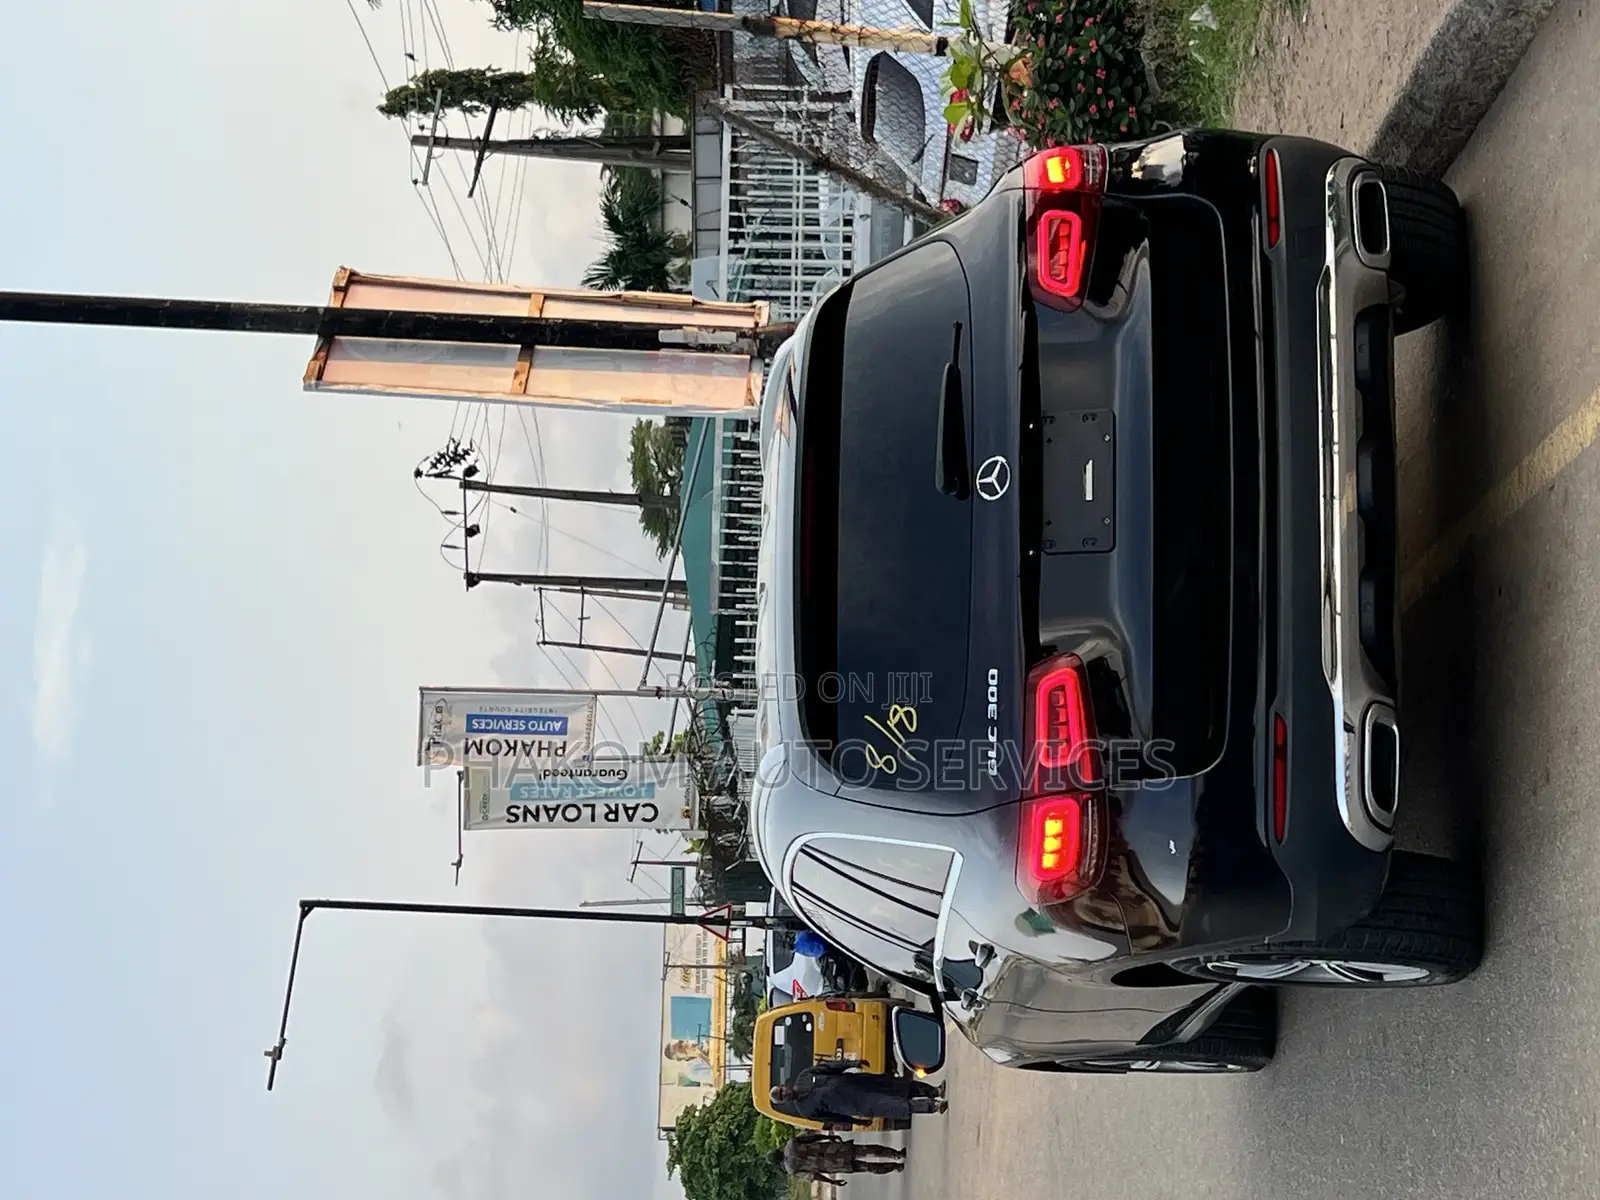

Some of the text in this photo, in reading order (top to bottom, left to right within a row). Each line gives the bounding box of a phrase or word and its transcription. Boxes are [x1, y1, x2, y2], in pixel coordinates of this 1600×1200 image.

[471, 718, 563, 732] AUTO SERVICES
[987, 668, 998, 776] GLC 300
[464, 737, 567, 757] PHAKOM
[539, 768, 628, 781] Guaranteed!
[520, 784, 646, 800] LOWEST RATES
[506, 802, 659, 824] CAR LOANS
